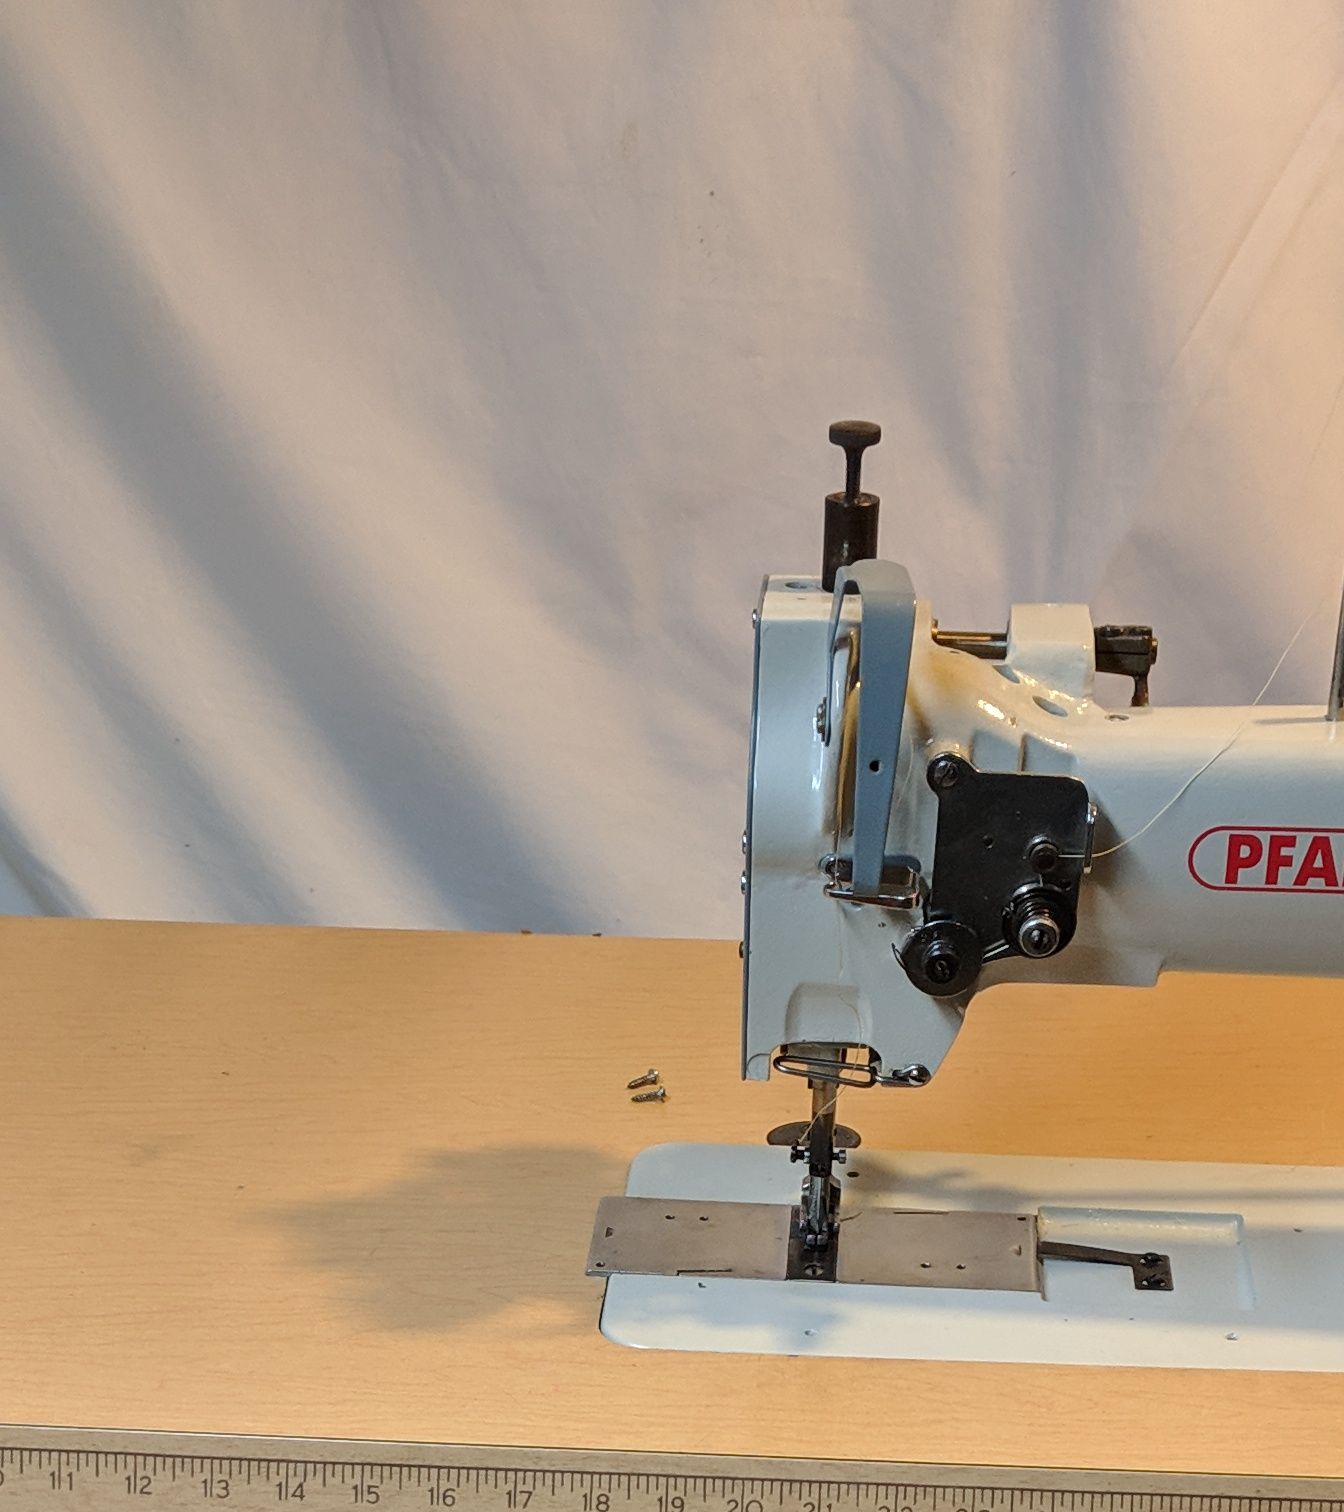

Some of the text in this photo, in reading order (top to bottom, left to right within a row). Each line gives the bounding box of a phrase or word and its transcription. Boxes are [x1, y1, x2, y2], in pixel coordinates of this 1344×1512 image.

[50, 1470, 74, 1492] 11
[125, 1473, 153, 1495] 12
[202, 1476, 231, 1499] 13
[275, 1480, 306, 1501] 14
[352, 1483, 380, 1505] 15
[428, 1486, 457, 1508] 16
[505, 1489, 532, 1509] 17
[581, 1491, 610, 1512] 18
